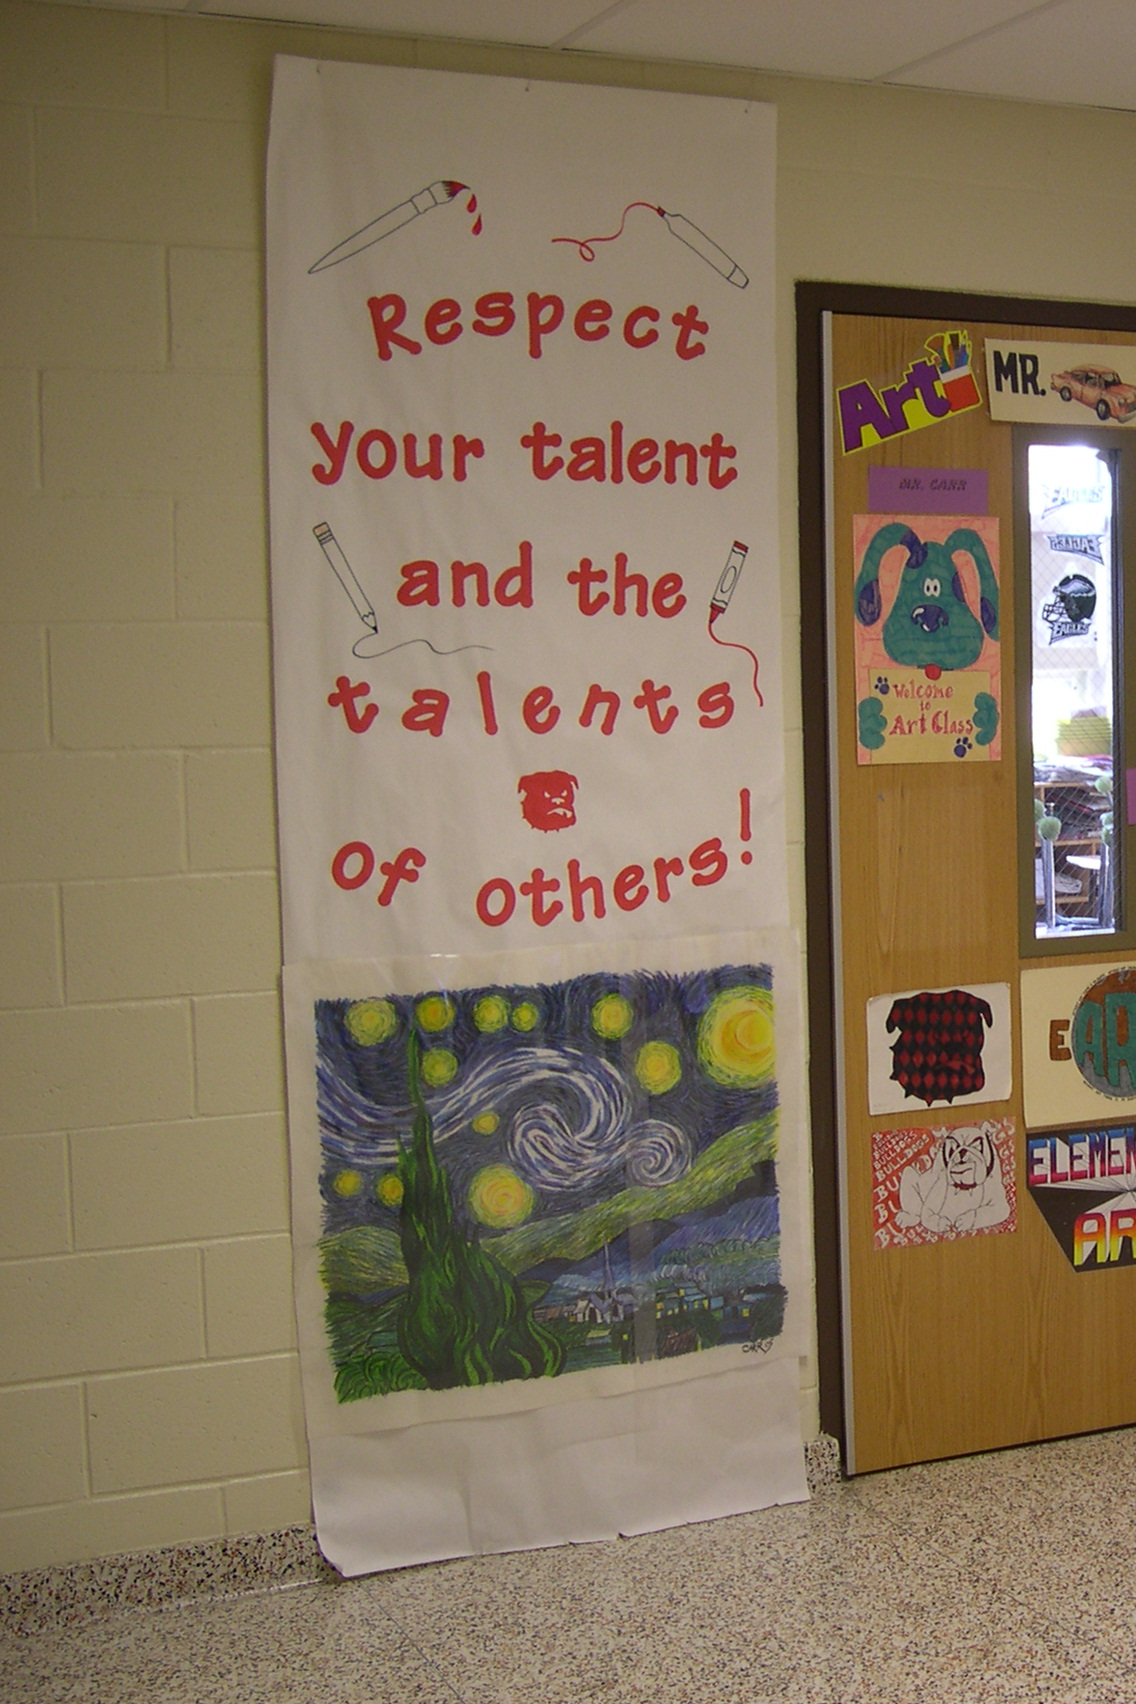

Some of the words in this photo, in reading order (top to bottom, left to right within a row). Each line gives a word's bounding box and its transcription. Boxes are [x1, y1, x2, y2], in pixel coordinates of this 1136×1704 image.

[367, 292, 708, 361] Respect
[993, 350, 1047, 397] MR.
[836, 362, 951, 453] Art
[311, 421, 484, 485] your
[520, 421, 737, 490] talent
[397, 541, 533, 608] and
[567, 553, 686, 619] the
[328, 671, 734, 737] talents
[889, 713, 928, 735] Art
[931, 710, 973, 734] Class
[893, 679, 953, 699] Welcome
[920, 700, 931, 711] to
[476, 788, 752, 926] others!
